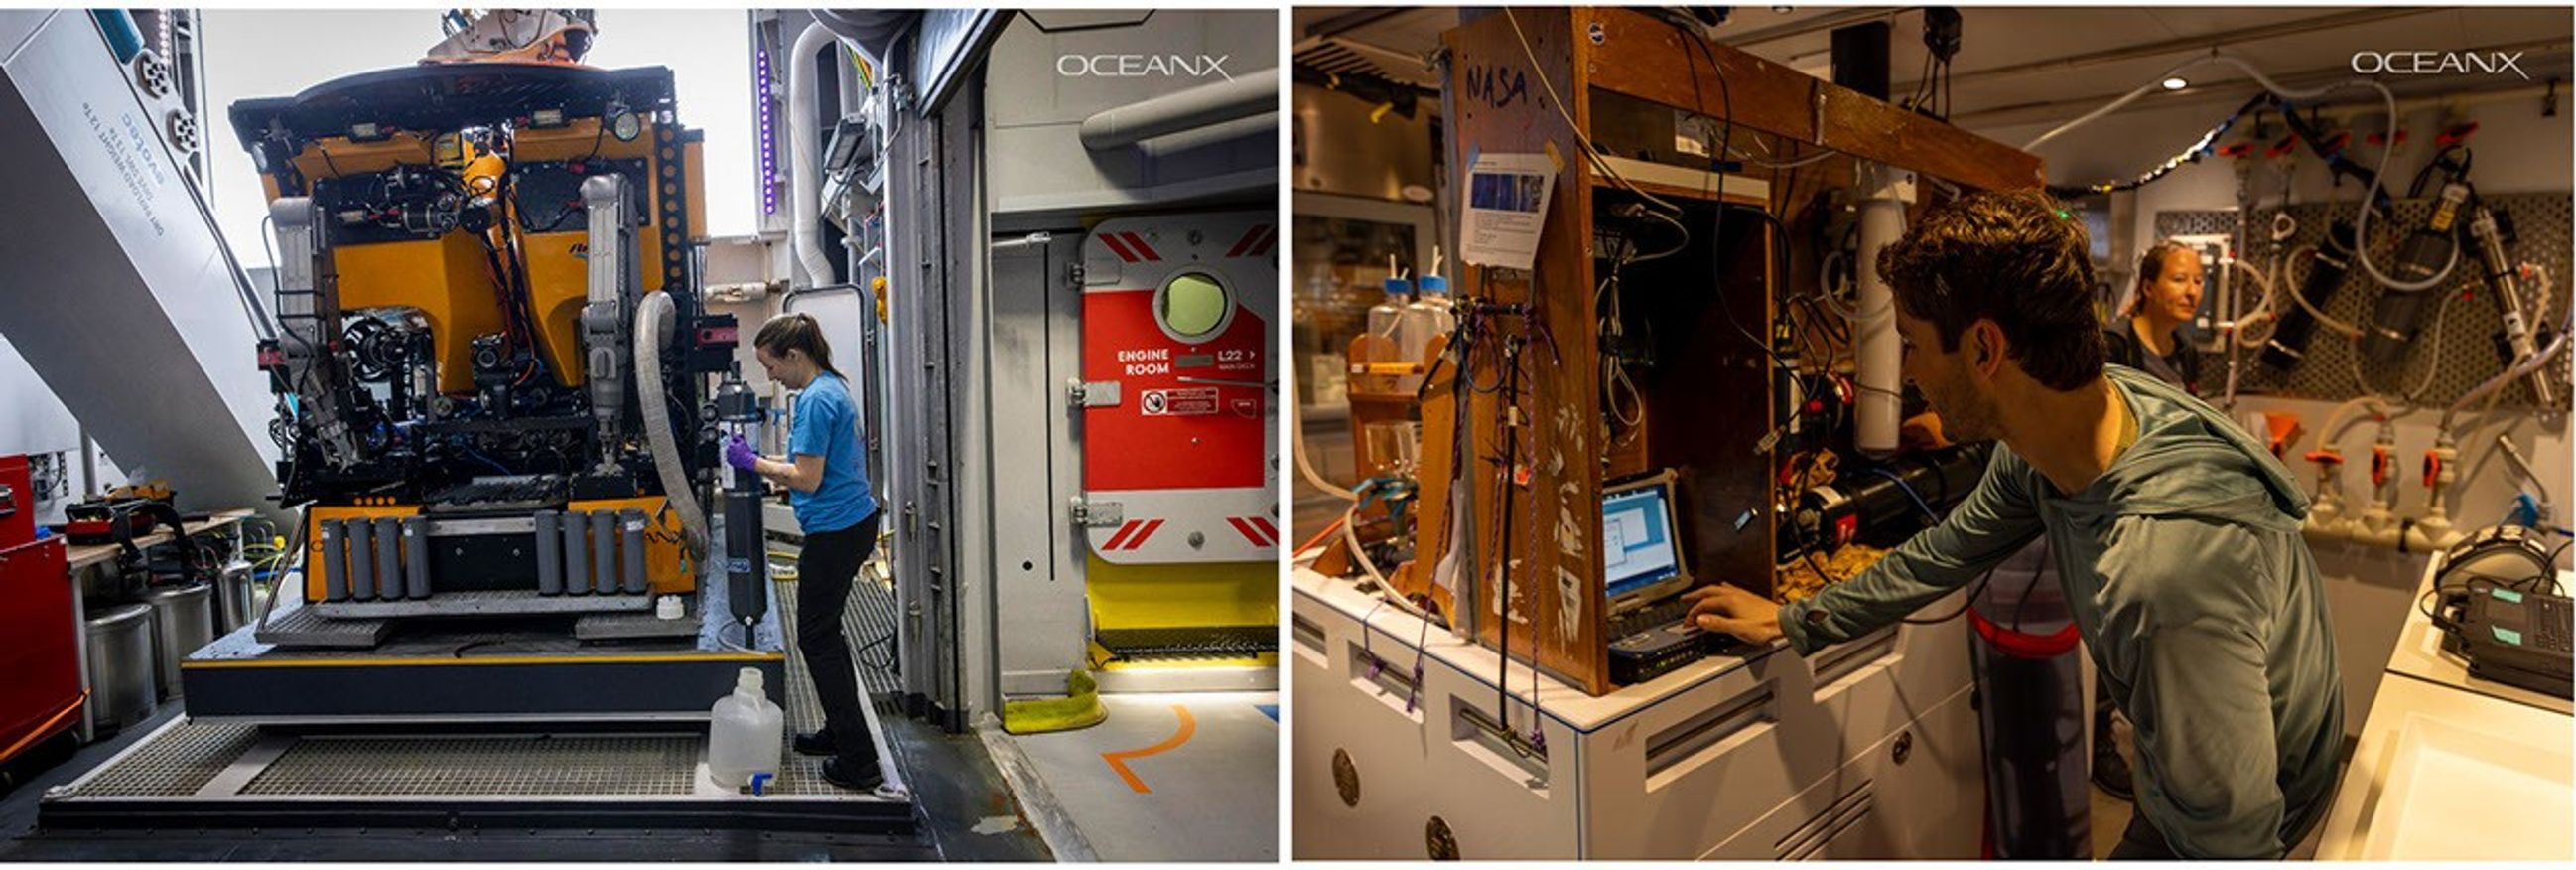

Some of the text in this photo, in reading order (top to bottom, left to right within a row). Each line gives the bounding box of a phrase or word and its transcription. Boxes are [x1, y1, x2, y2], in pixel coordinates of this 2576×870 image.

[1467, 65, 1527, 109] NASA
[121, 113, 164, 184] evotec
[1118, 349, 1168, 362] ENGINE
[1218, 350, 1243, 362] L22
[1126, 363, 1169, 375] ROOM
